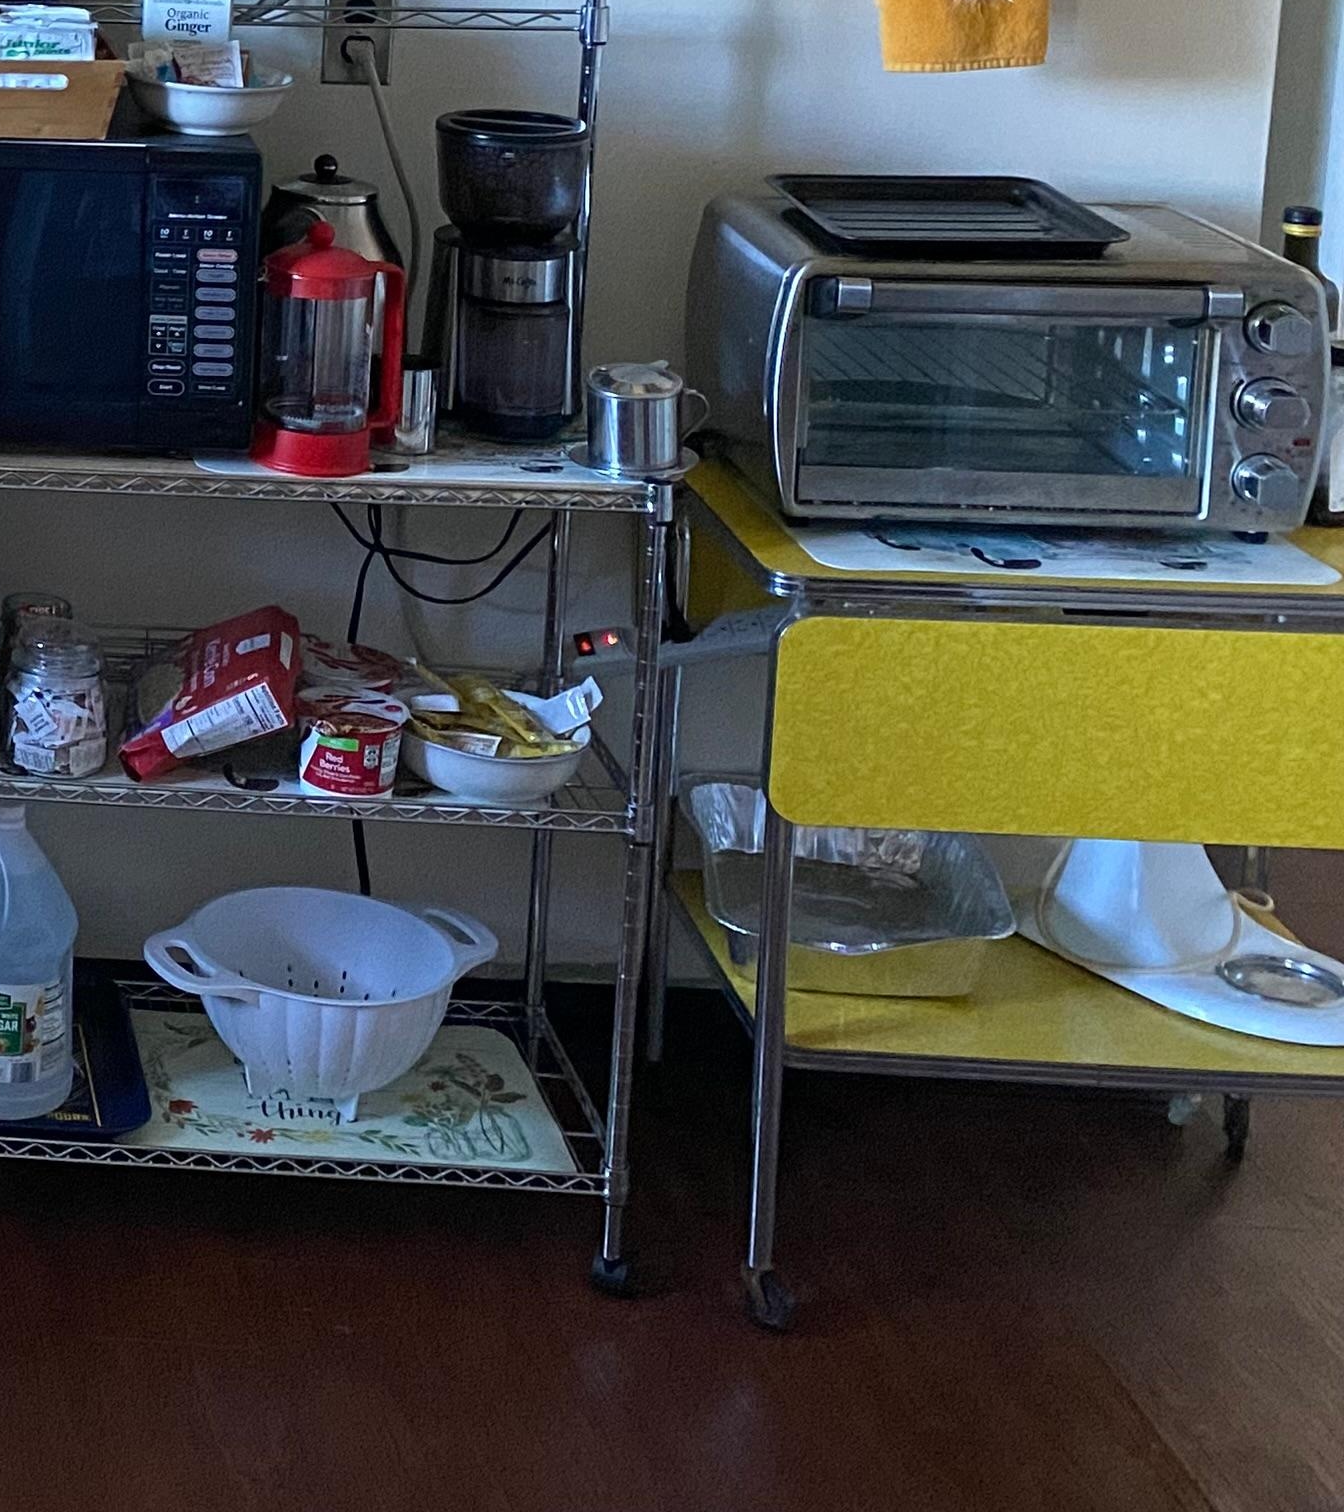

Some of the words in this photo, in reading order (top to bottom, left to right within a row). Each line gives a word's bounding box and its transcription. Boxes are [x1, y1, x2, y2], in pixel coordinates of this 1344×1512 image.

[166, 7, 210, 21] Organic
[165, 19, 212, 37] Ginger
[325, 752, 344, 764] Red
[319, 759, 351, 773] Berries
